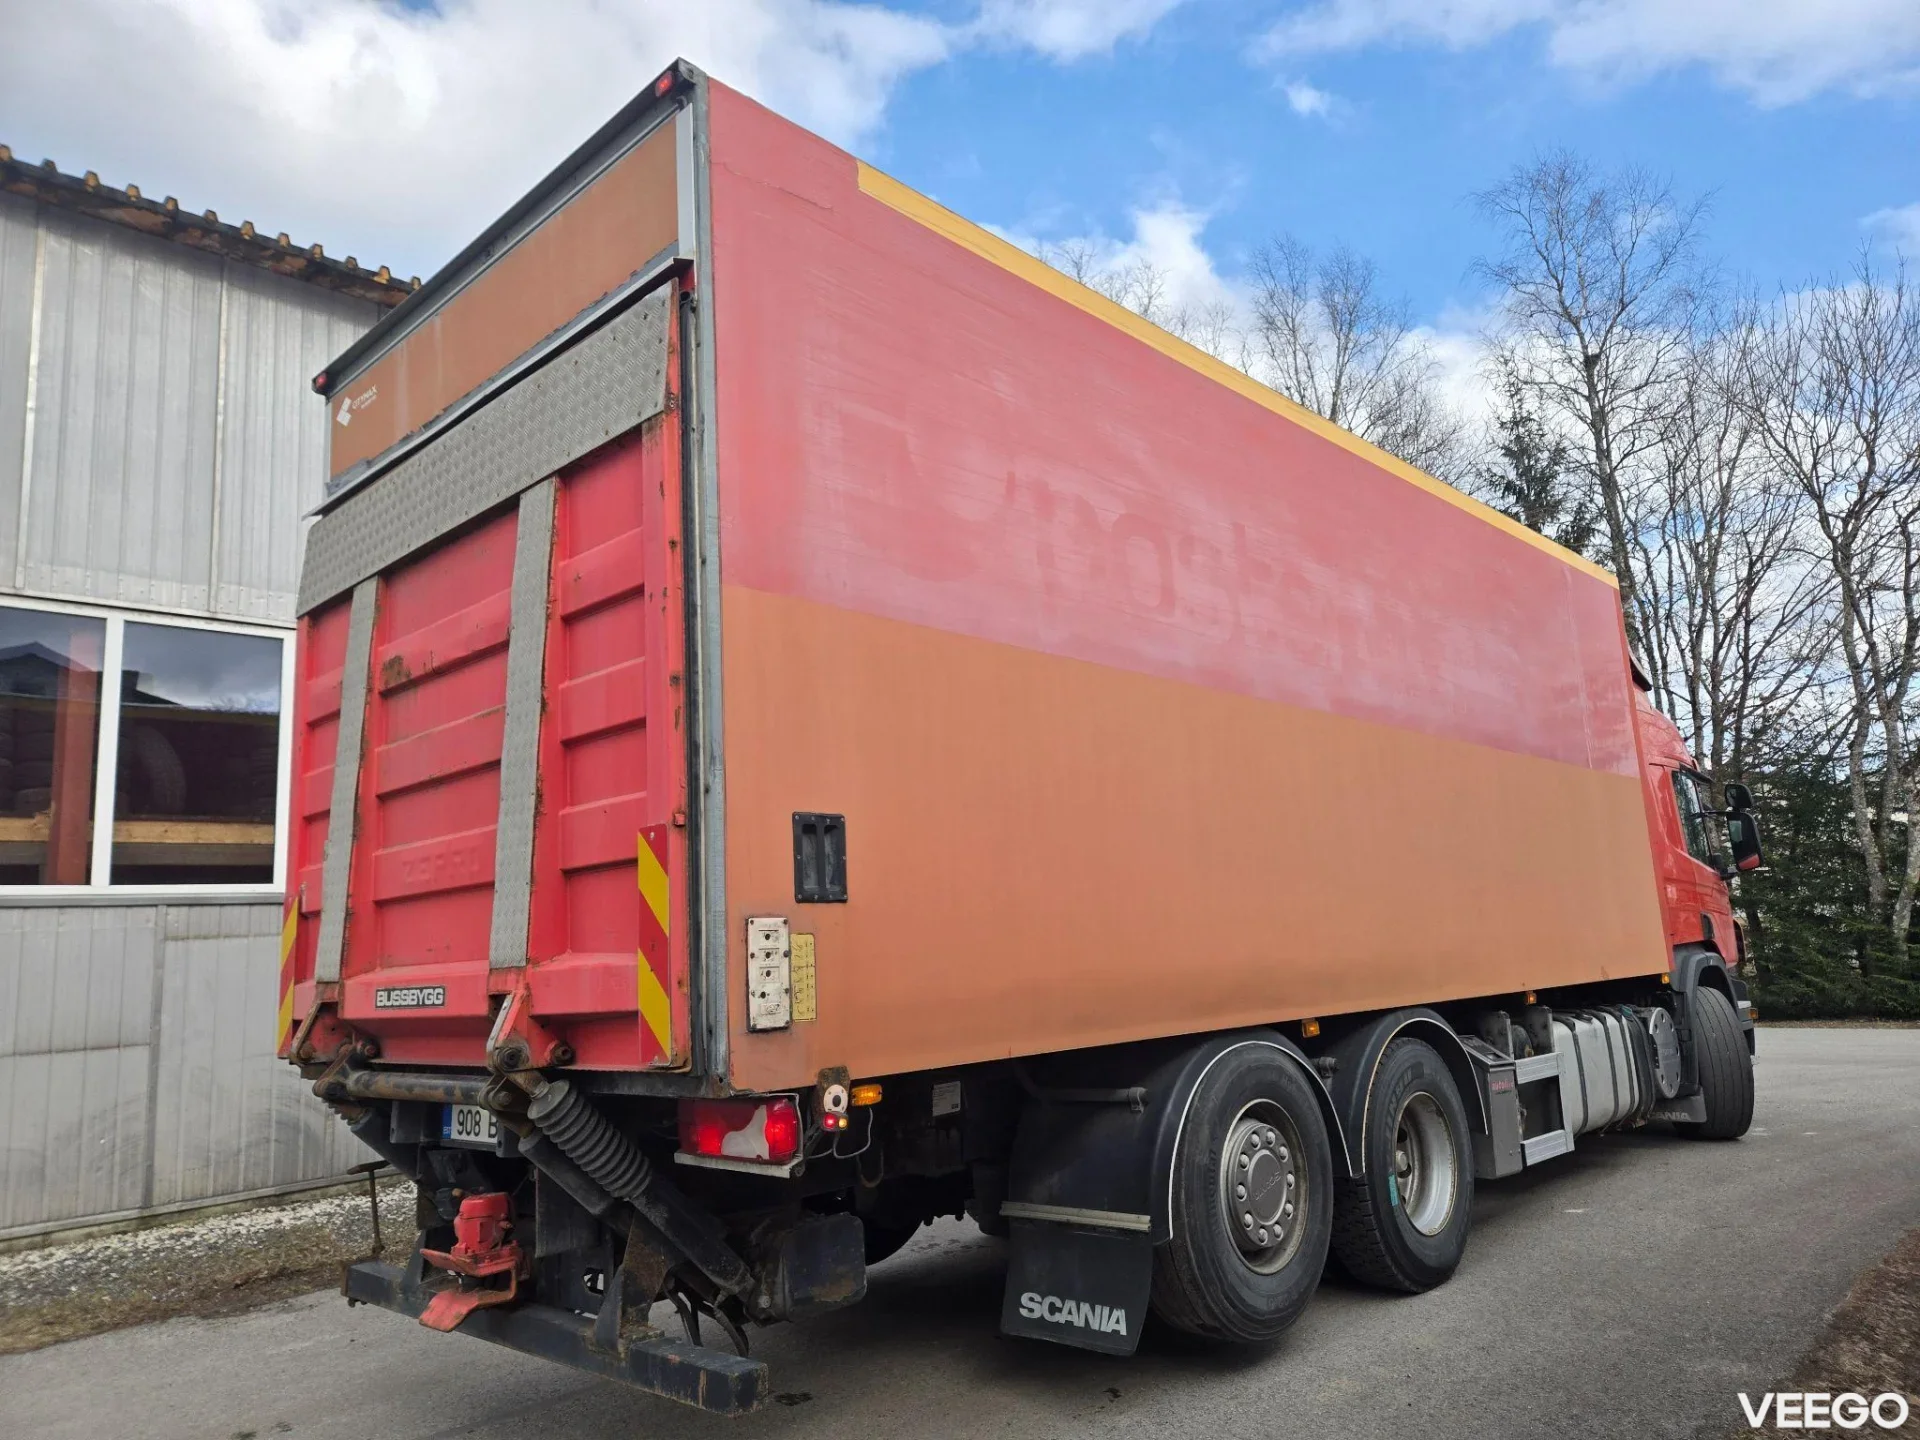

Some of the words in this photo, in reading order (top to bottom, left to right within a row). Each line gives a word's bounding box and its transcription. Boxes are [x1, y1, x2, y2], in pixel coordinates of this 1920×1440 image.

[376, 988, 444, 1006] BUSSBYGG
[457, 1109, 481, 1137] 908
[1019, 1291, 1127, 1336] SCANIA
